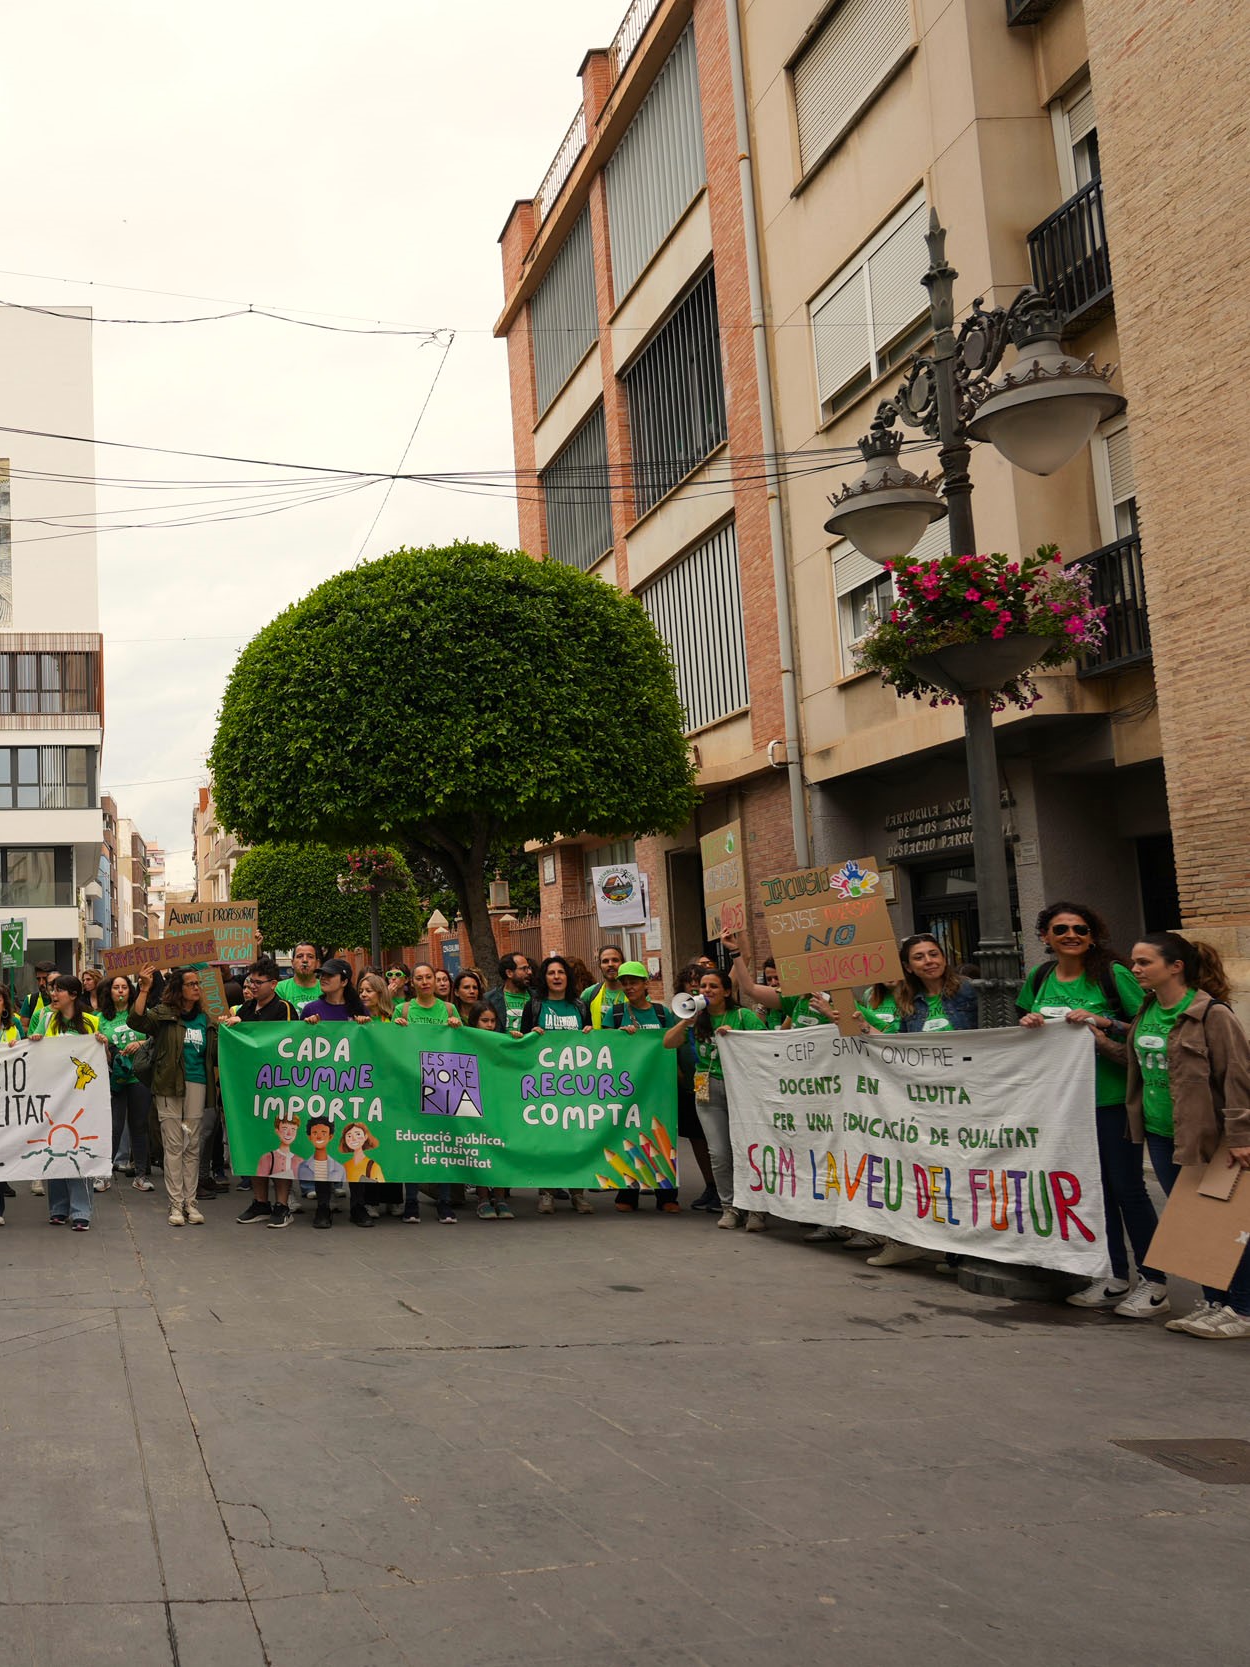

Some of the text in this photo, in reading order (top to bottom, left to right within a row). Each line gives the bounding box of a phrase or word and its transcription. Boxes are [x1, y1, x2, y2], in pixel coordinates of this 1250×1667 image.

[885, 804, 939, 828] PARROQUIA
[898, 826, 910, 840] DE
[918, 820, 938, 836] LOS
[887, 838, 936, 859] DESPACHO
[771, 908, 820, 935] SENSE
[805, 924, 856, 952] NO
[544, 1013, 552, 1026] LA
[277, 1037, 350, 1063] CADA
[421, 1053, 445, 1067] IES
[538, 1045, 613, 1072] CADA
[786, 1037, 954, 1068] CEIP SANT ONOFRE
[255, 1063, 374, 1091] ALUMNE
[520, 1071, 635, 1101] RECURS
[779, 1075, 971, 1105] DOCENTS EN LLUITA
[253, 1093, 383, 1122] IMPORTA
[522, 1102, 642, 1131] COMPTA
[395, 1131, 506, 1148] Educació pública,
[774, 1112, 796, 1132] PER
[806, 1112, 834, 1133] UNA
[929, 1126, 950, 1148] DE
[414, 1153, 492, 1169] i de qualitat
[423, 1142, 479, 1157] inclusiva
[749, 1144, 796, 1198] SOM
[913, 1163, 961, 1227] DEL
[969, 1169, 1096, 1242] FUTUR
